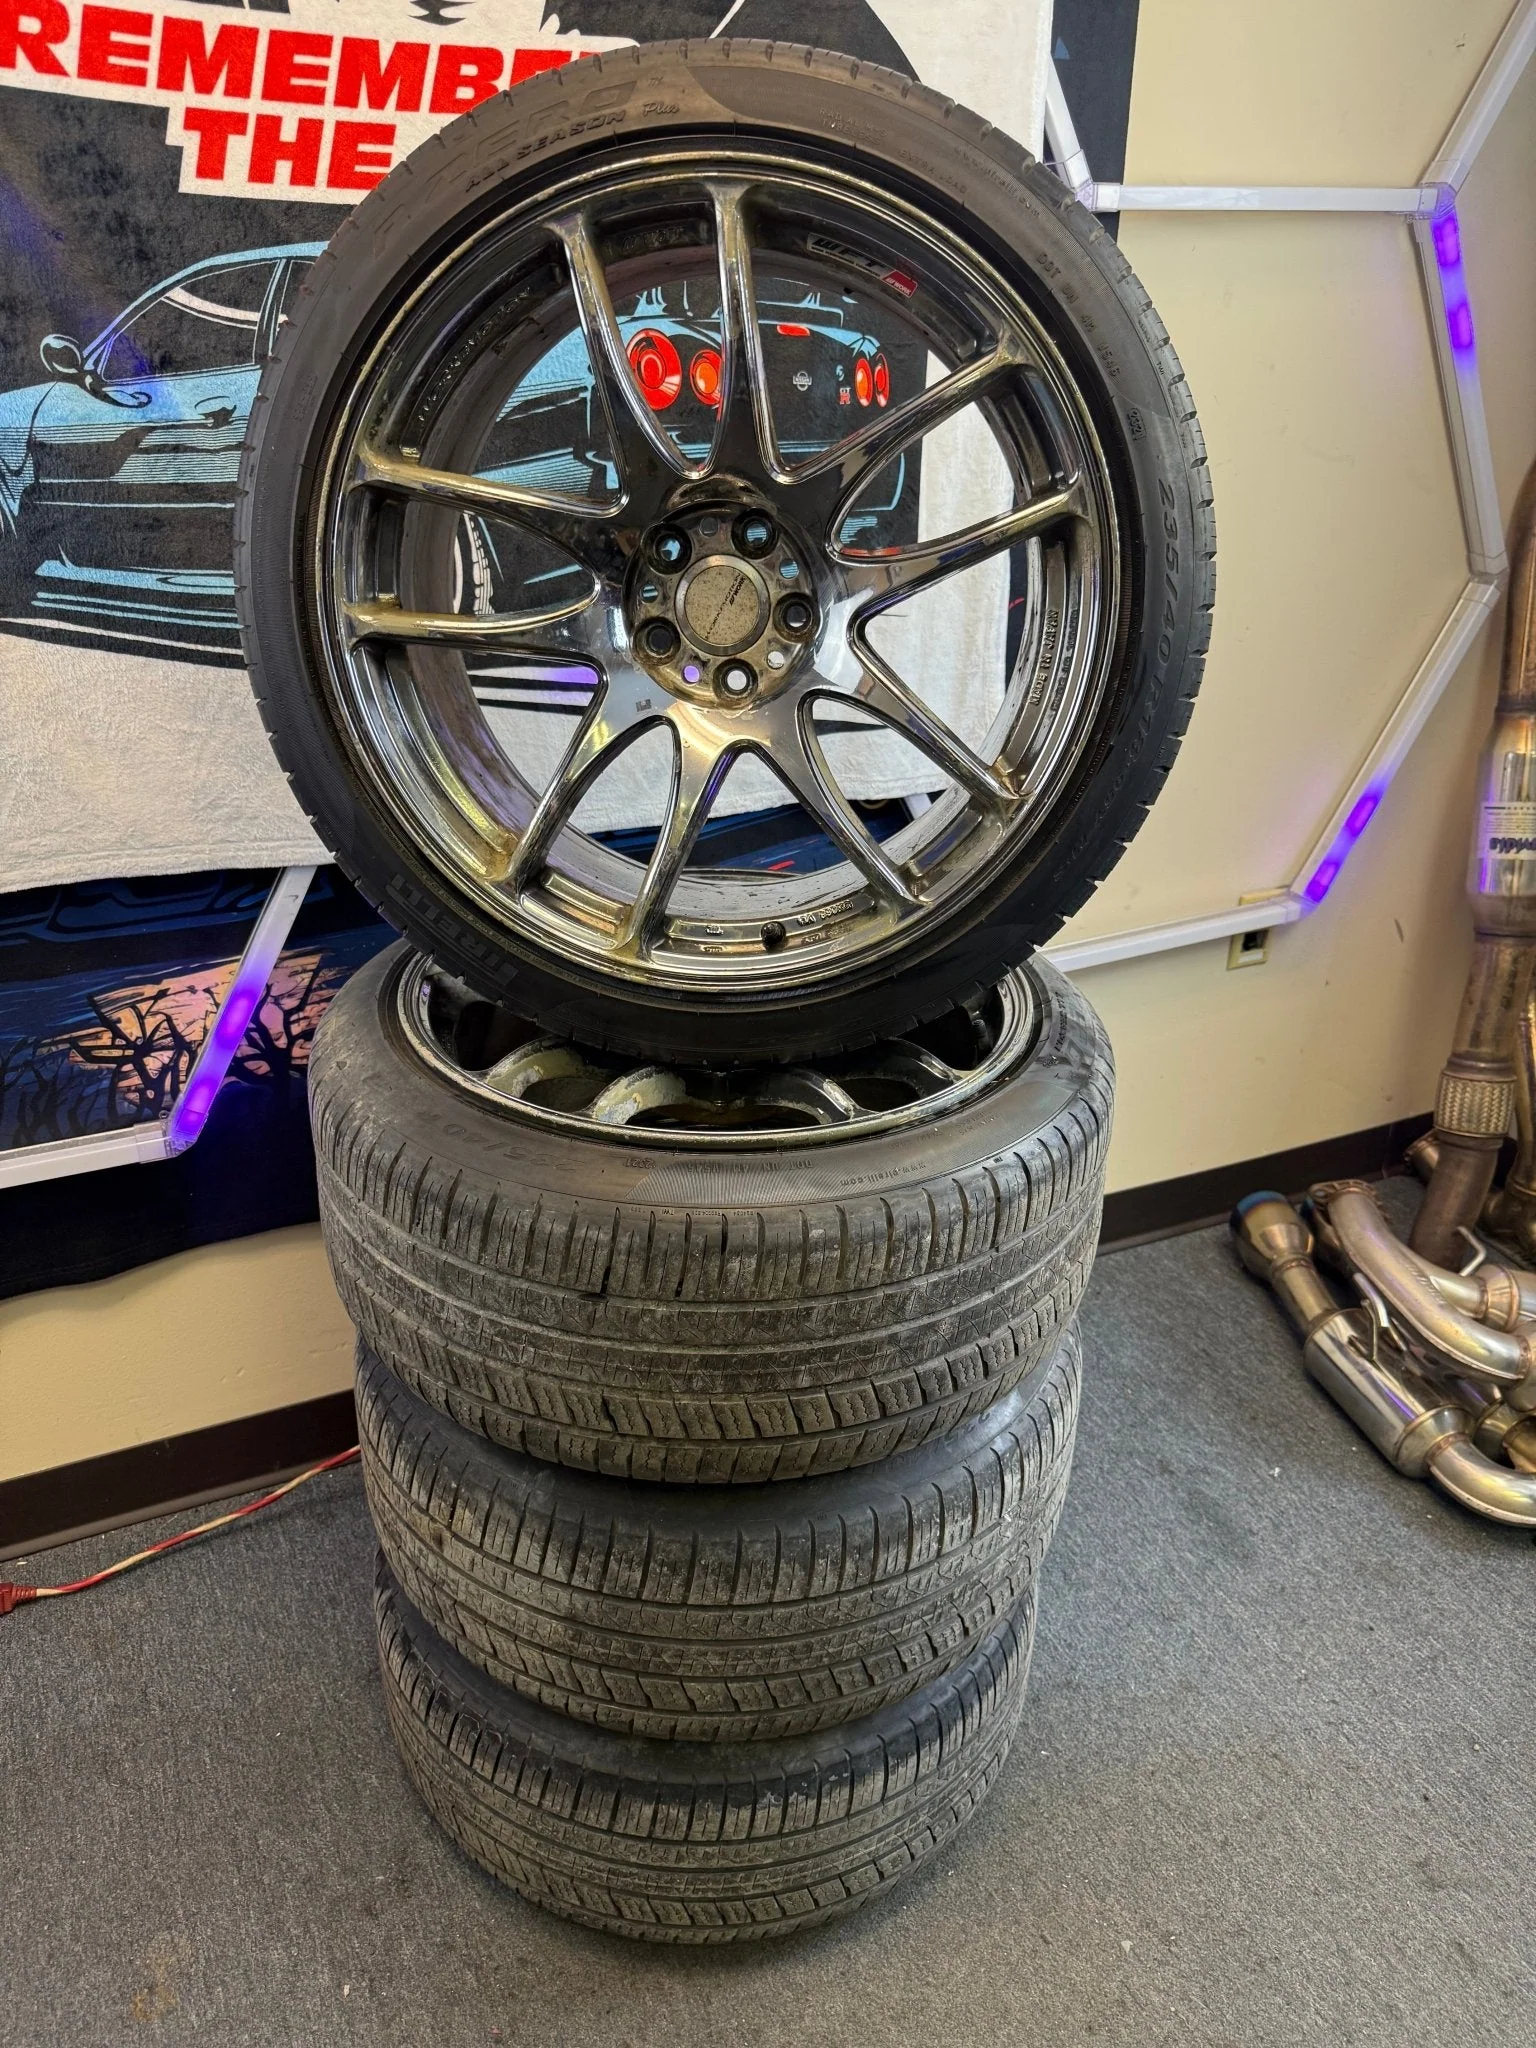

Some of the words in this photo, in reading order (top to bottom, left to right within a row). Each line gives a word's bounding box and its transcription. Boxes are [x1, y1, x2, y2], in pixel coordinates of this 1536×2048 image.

[0, 0, 602, 114] REMEMB
[183, 107, 397, 190] THE
[516, 110, 627, 160] SEASON
[642, 101, 681, 117] Plus
[1156, 477, 1182, 666] 235/40
[1043, 609, 1060, 650] JAPAN
[1040, 653, 1052, 669] IN
[1029, 672, 1048, 707] MADE
[840, 1160, 927, 1187] www.pirelli.com
